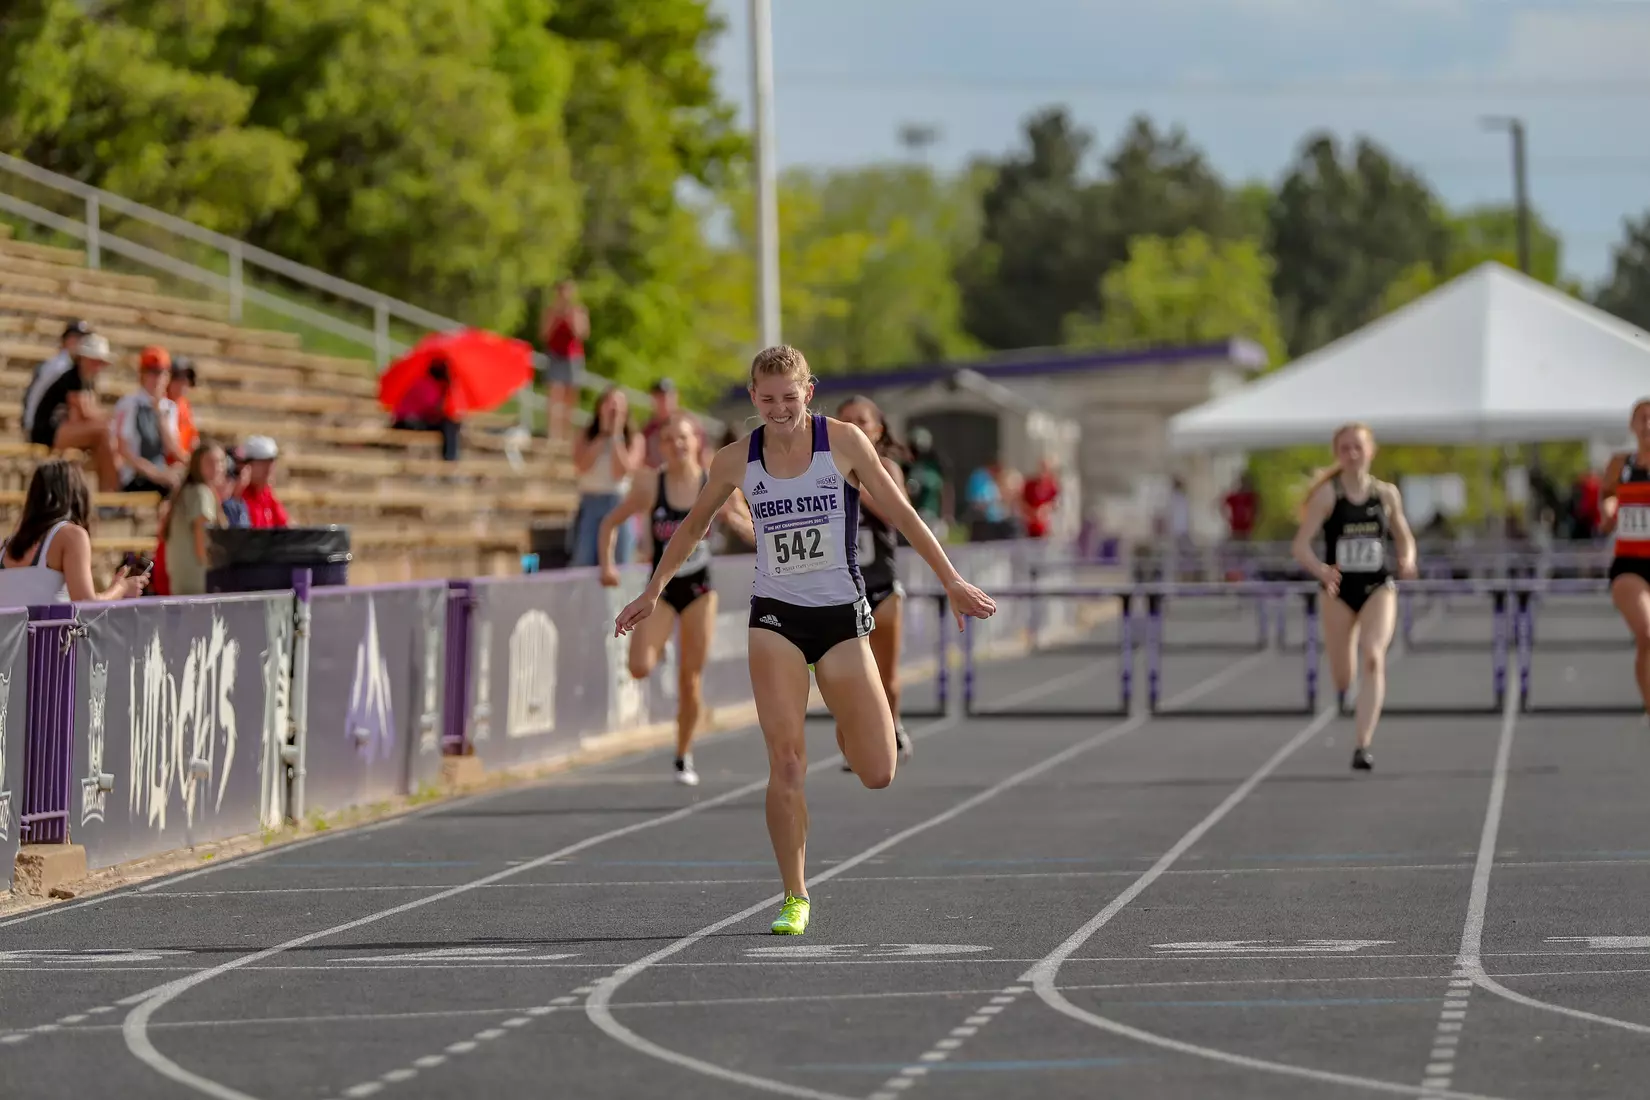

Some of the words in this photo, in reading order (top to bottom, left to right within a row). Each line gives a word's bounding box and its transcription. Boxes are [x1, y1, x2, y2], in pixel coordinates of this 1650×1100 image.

[752, 499, 793, 519] WEBER
[796, 494, 837, 512] STATE
[774, 528, 824, 564] 542
[759, 615, 782, 628] adidas
